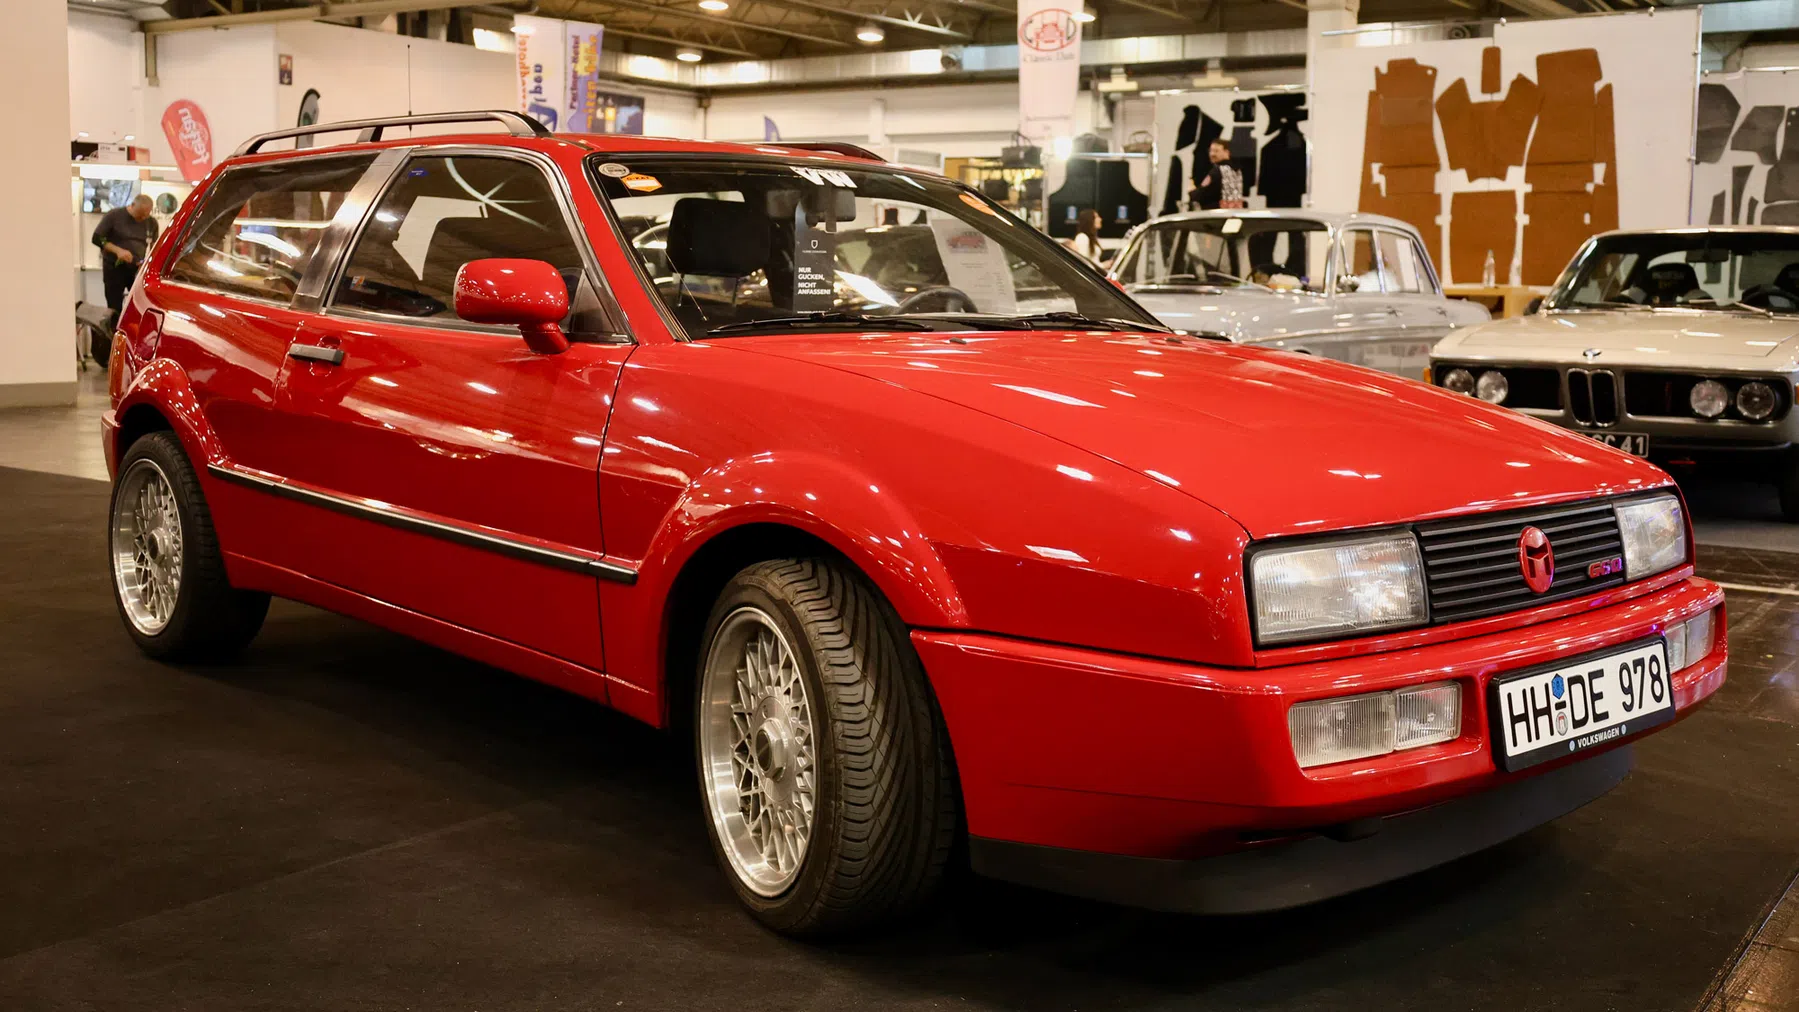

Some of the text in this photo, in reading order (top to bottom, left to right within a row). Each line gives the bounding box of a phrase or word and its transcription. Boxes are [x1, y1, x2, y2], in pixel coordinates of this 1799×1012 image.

[797, 273, 825, 281] GUCKEN,
[1620, 435, 1645, 455] 41
[1588, 557, 1623, 579] G60
[1619, 654, 1664, 712] 978
[1577, 728, 1620, 748] VOLKSWAGEN
